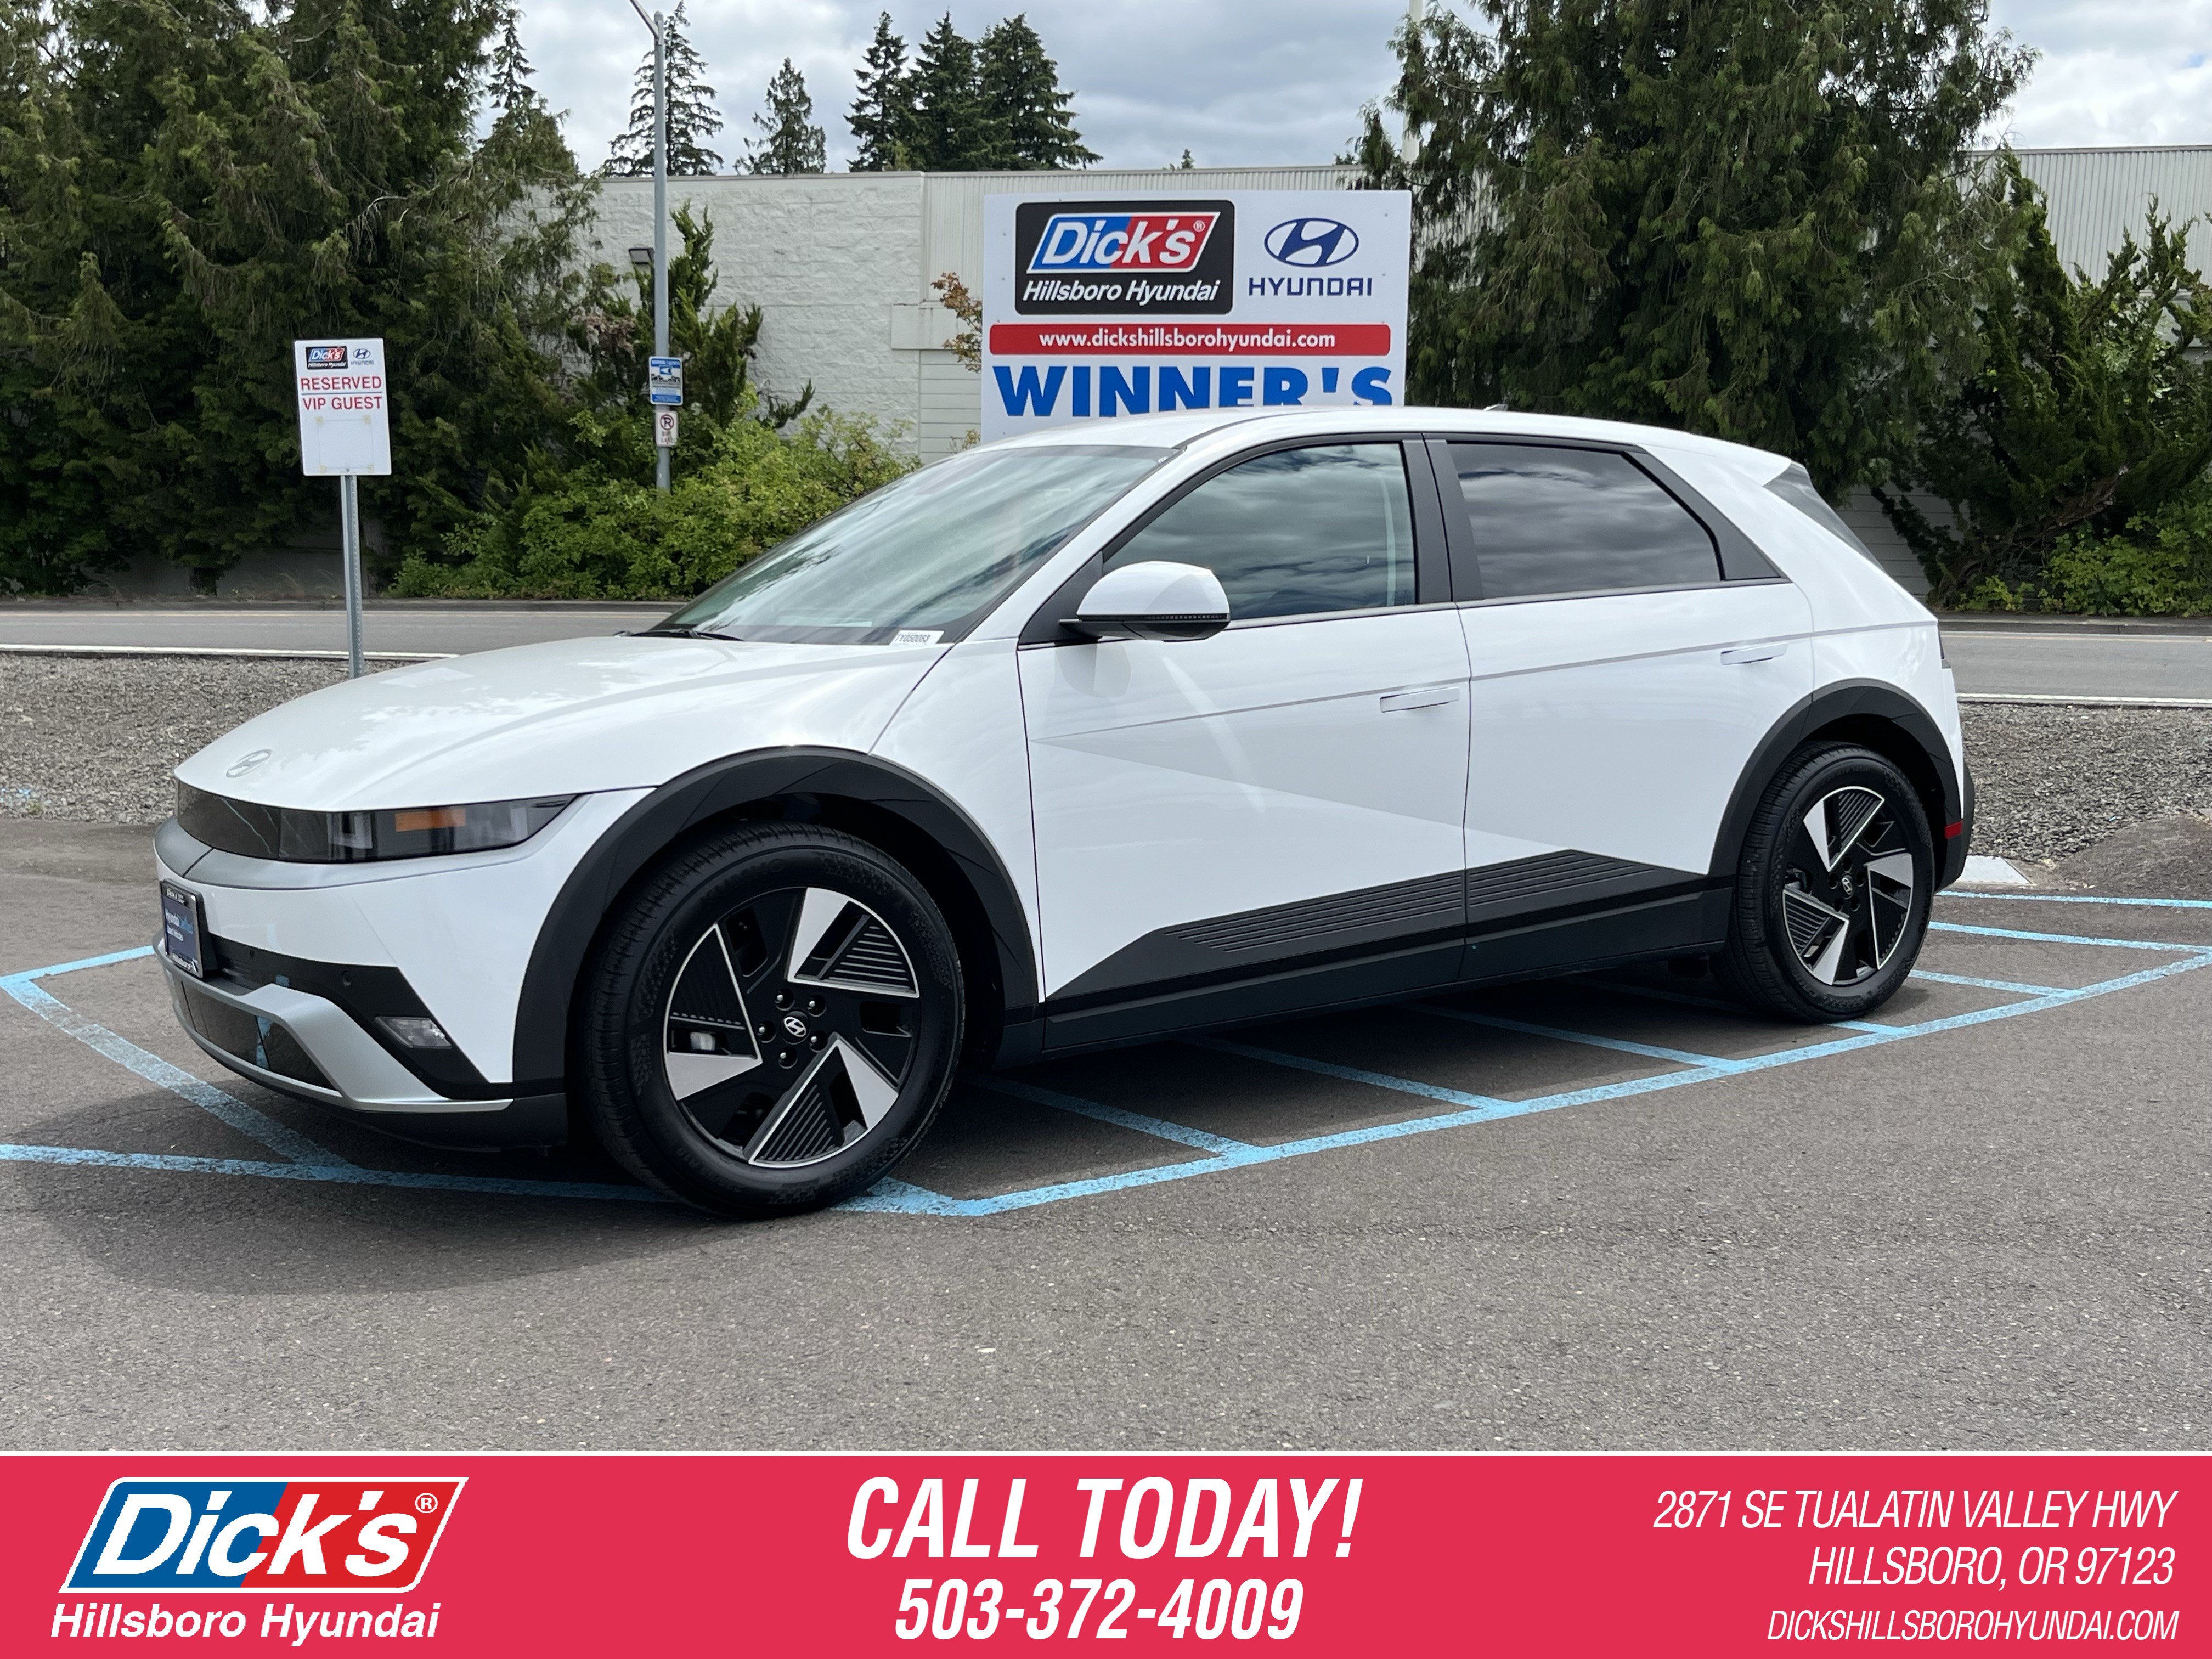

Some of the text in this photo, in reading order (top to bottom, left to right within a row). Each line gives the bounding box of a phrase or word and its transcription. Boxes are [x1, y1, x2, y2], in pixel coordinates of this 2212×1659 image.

[1041, 219, 1196, 265] Dick's
[1023, 279, 1220, 306] Hillsboro Hyundai
[1249, 277, 1372, 297] HYUNDAI
[1039, 327, 1336, 352] www.dickshillsborohyundai.com
[312, 349, 341, 360] Dick's
[301, 376, 382, 390] RESERVED
[992, 366, 1392, 417] WINNER'S
[303, 397, 382, 410] VIP GUEST
